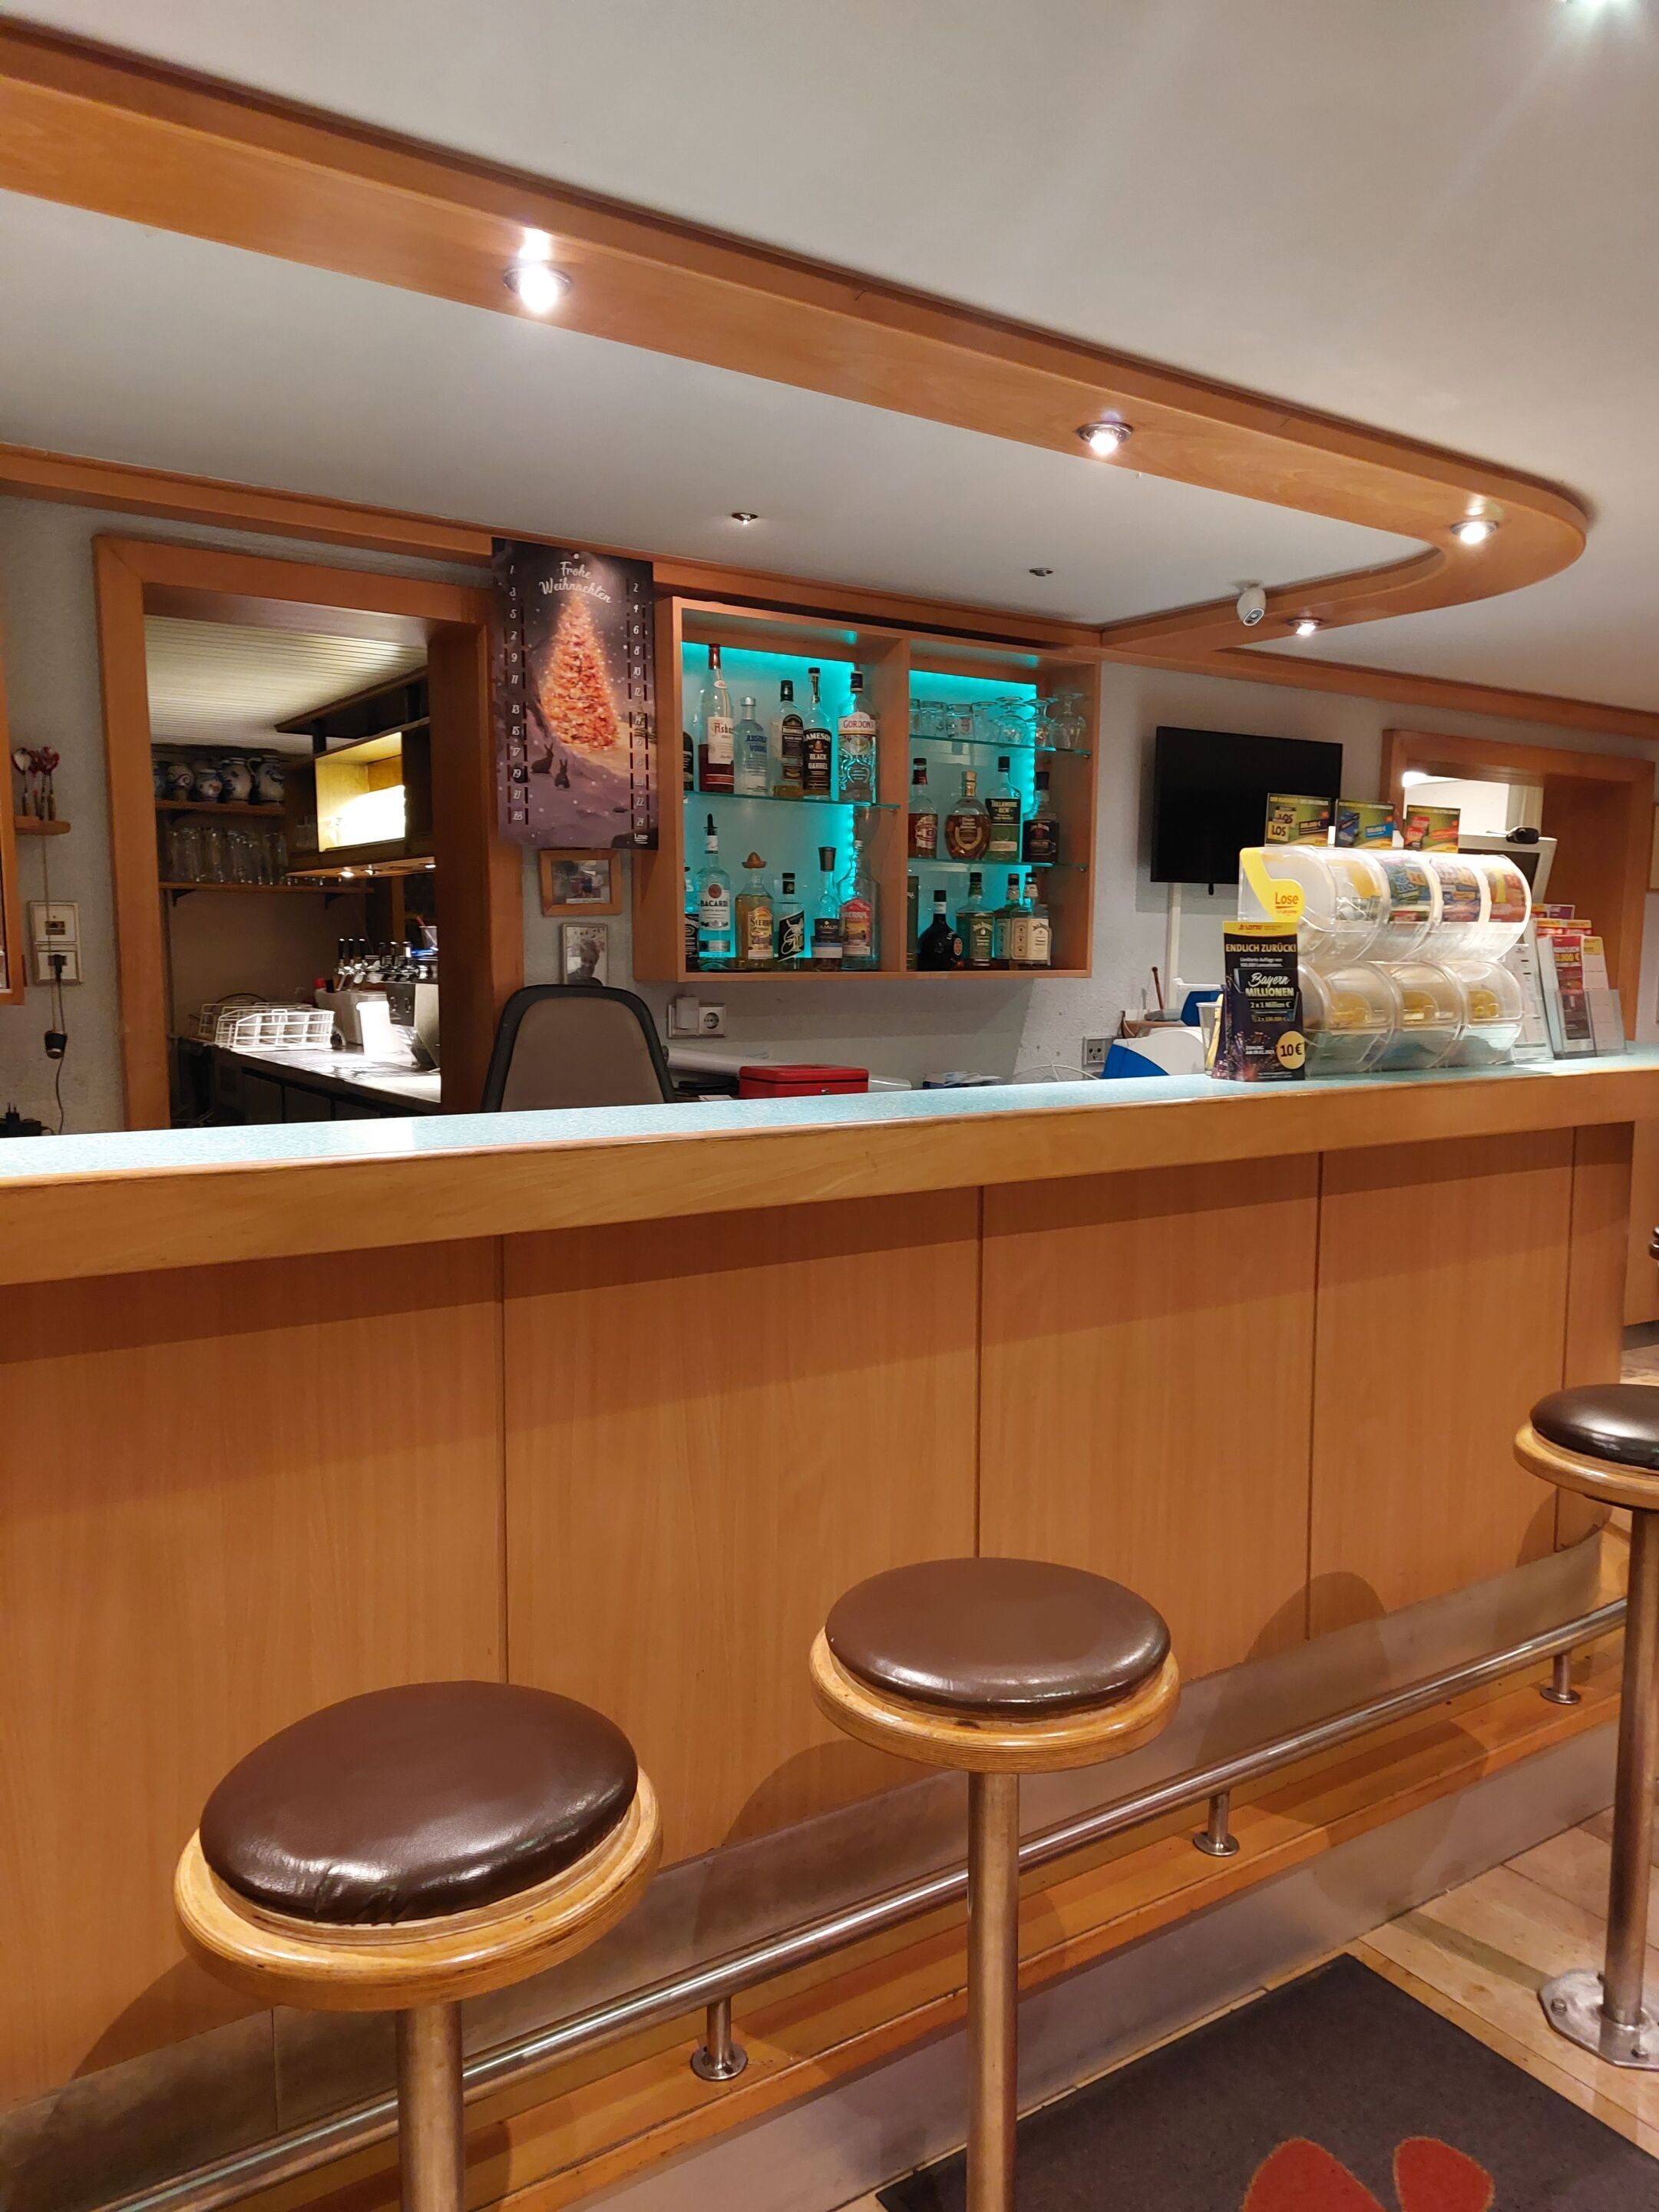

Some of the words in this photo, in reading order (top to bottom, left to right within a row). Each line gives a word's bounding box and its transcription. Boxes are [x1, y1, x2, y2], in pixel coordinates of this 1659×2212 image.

[559, 560, 591, 579] Frohe
[538, 577, 613, 603] Weihnachten
[633, 583, 639, 593] 2
[633, 604, 639, 613] 4
[633, 625, 639, 635] 6
[633, 646, 640, 656] 8
[511, 654, 517, 663] 9
[633, 666, 641, 676] 10
[511, 675, 519, 684] 11
[512, 769, 521, 779] 19
[1271, 825, 1287, 837] LOS
[1275, 891, 1299, 904] Lose
[1225, 943, 1259, 952] ENDLICH
[1261, 942, 1297, 952] ZURÜCK!
[1248, 972, 1290, 988] Bayern
[1244, 987, 1294, 997] MILLIONEN
